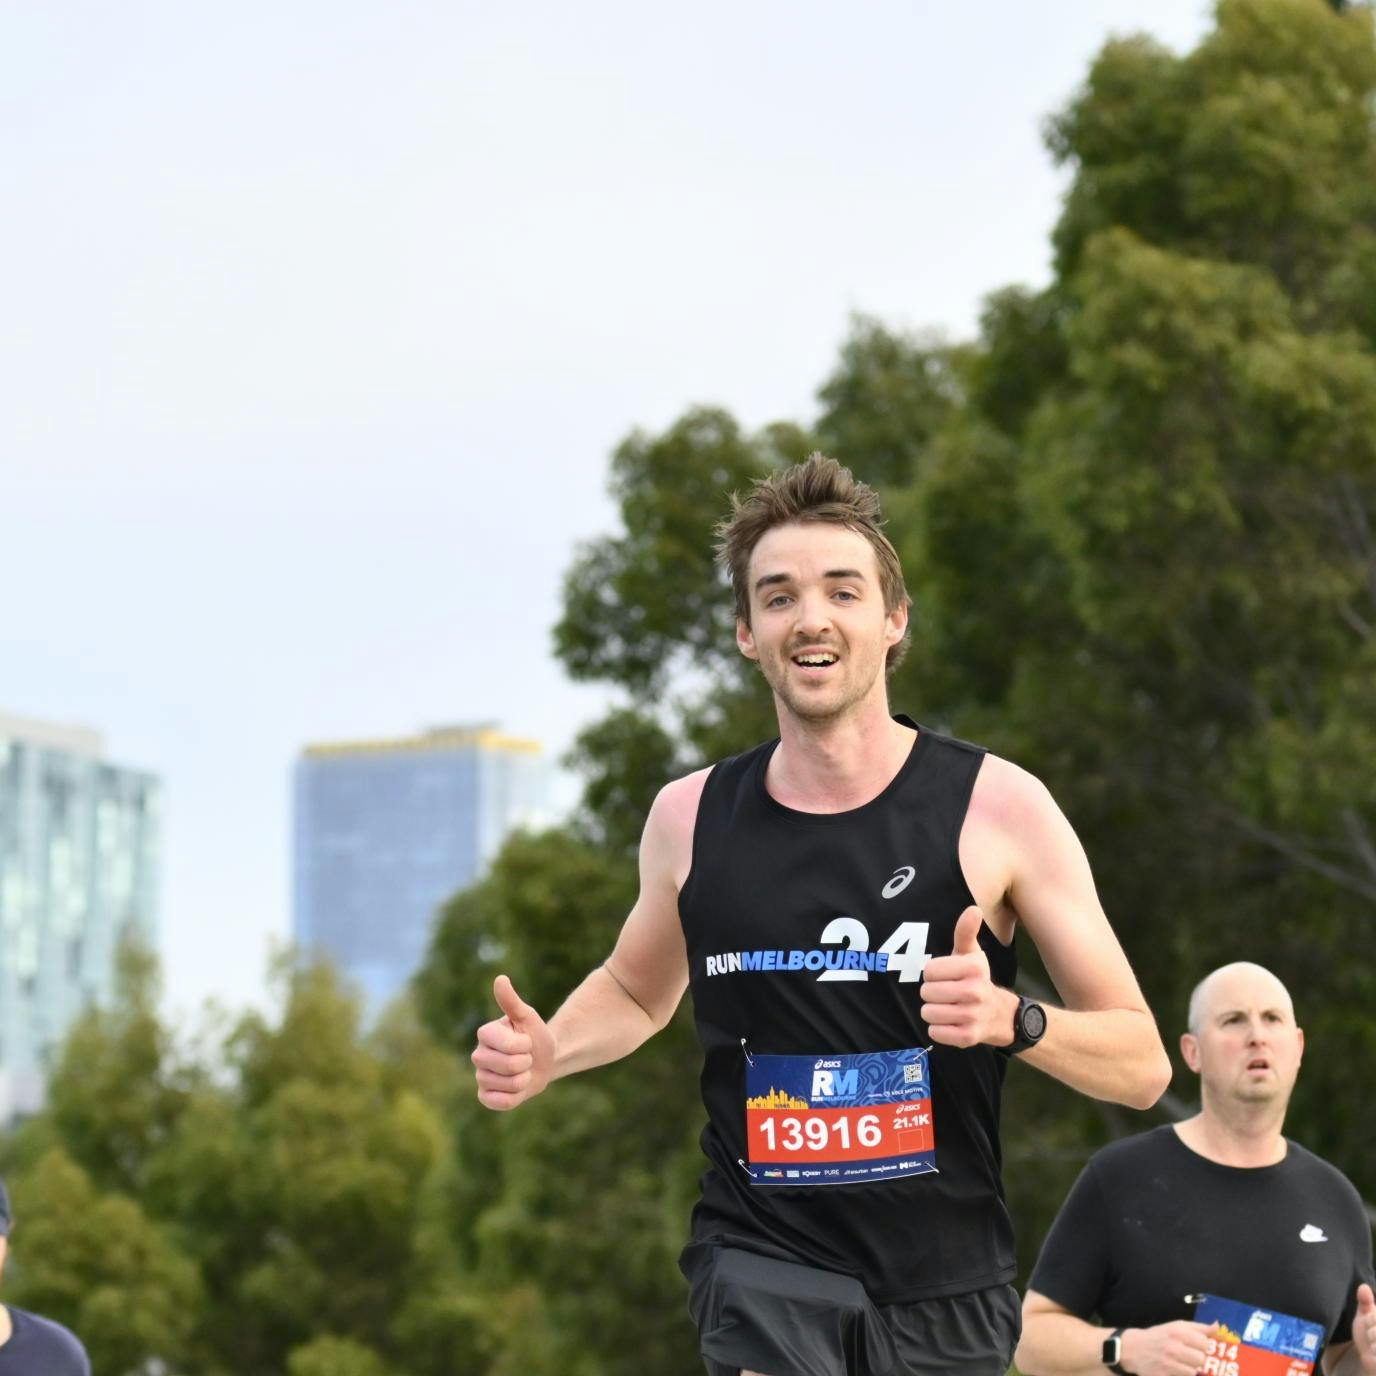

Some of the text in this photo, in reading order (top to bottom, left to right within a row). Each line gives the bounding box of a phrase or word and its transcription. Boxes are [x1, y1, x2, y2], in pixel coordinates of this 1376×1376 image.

[816, 917, 932, 983] 24
[812, 1070, 859, 1096] RM
[760, 1115, 882, 1151] 13916
[893, 1113, 930, 1129] 21.1K
